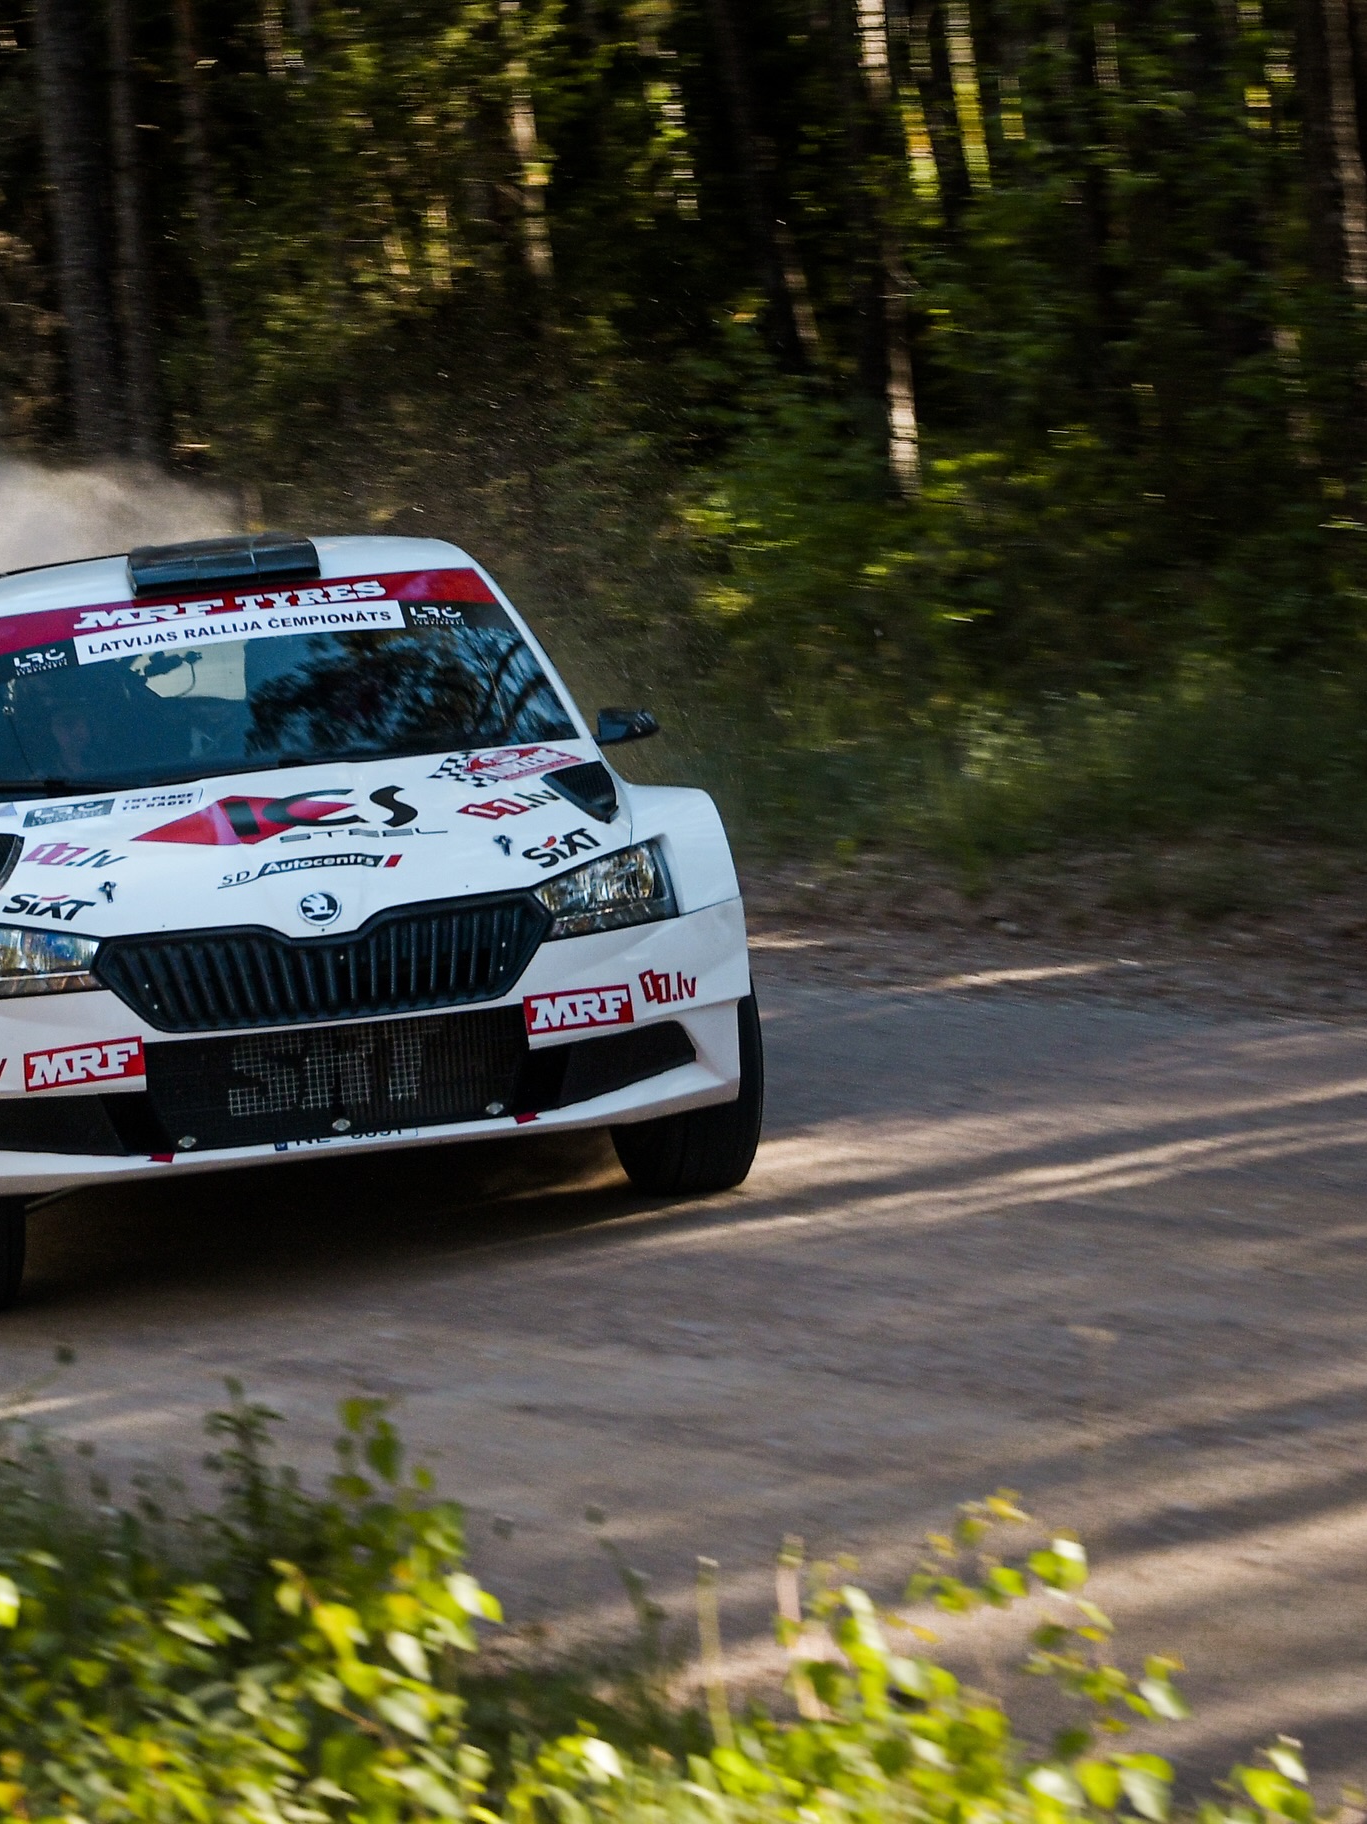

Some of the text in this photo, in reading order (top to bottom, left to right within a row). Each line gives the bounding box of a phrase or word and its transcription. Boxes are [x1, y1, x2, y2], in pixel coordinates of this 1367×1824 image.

[73, 580, 386, 629] MRF TYRES
[87, 631, 178, 655] LATVIJAS
[184, 621, 262, 640] RALLIJA
[269, 611, 392, 630] ČEMPIONĀTS
[223, 785, 419, 836] ICS
[456, 789, 561, 820] 11.lv
[20, 842, 130, 868] 11.lv
[221, 853, 376, 886] SD Autocentrs
[638, 968, 697, 1005] 11.lv
[530, 988, 629, 1031] MRF
[27, 1041, 139, 1088] MRF
